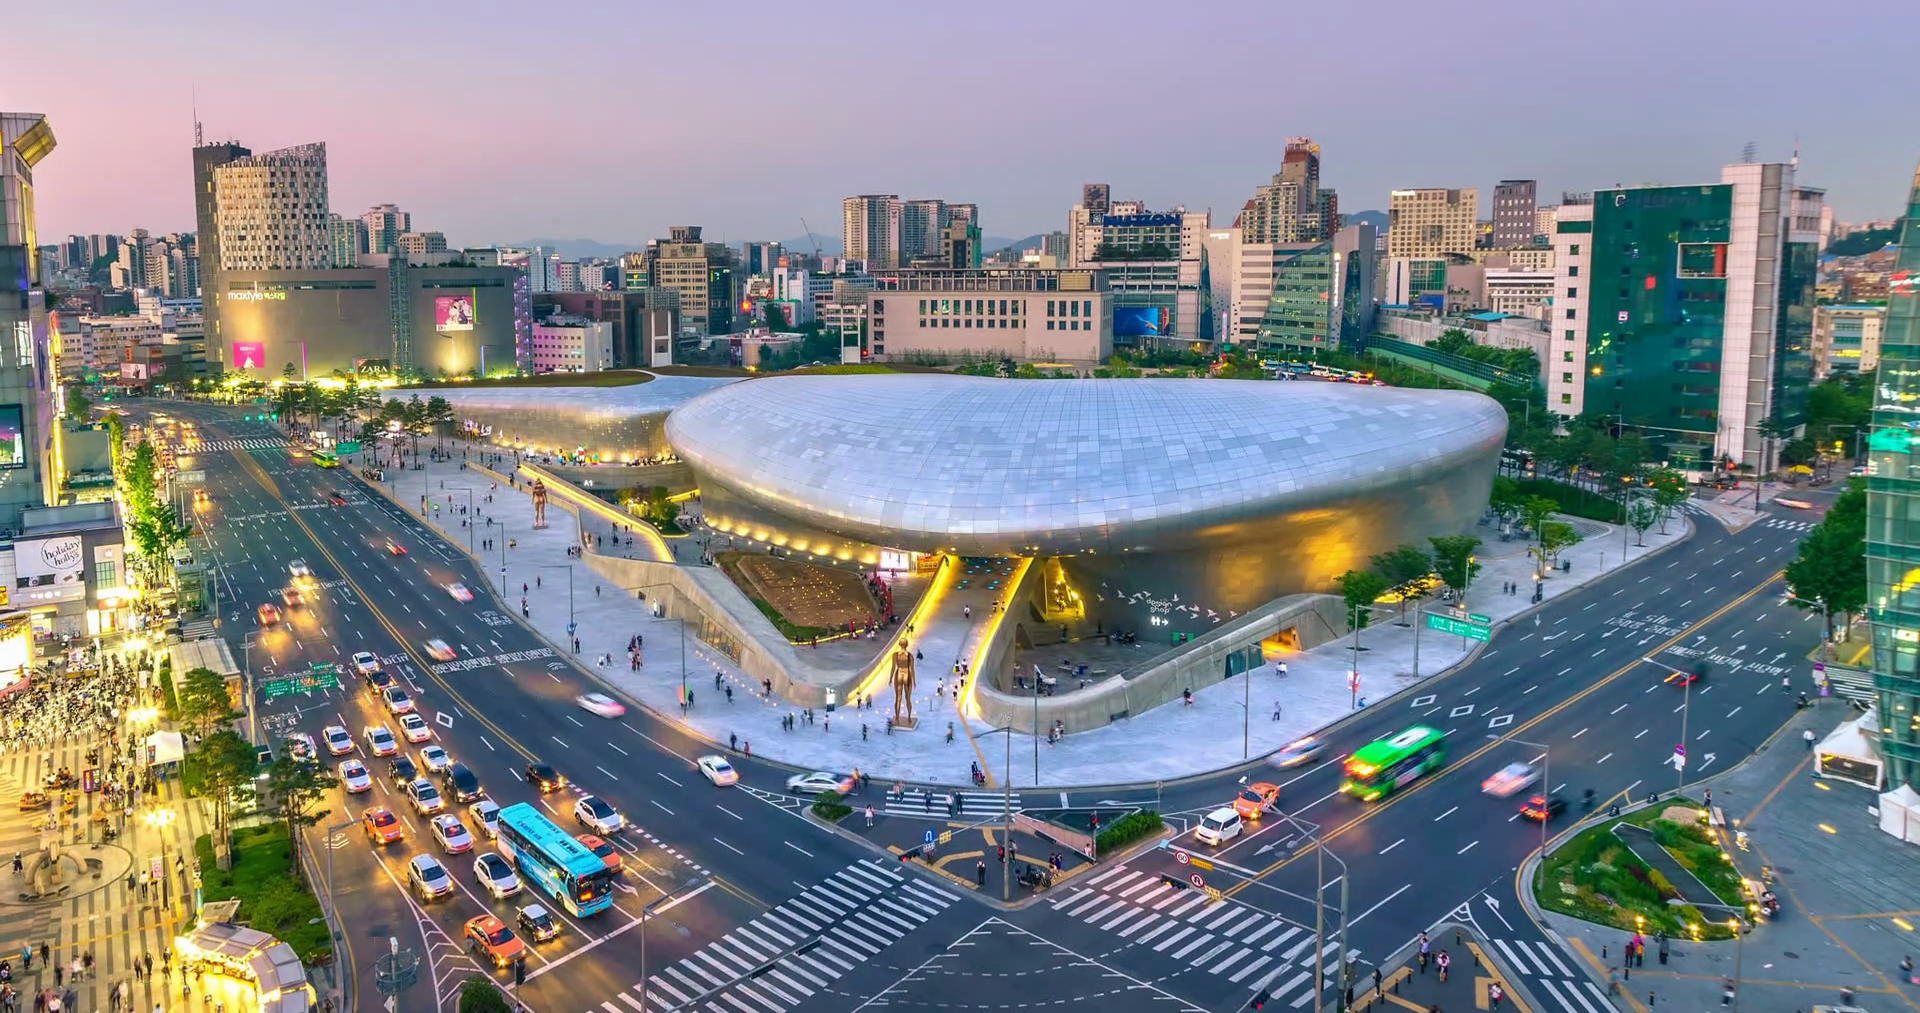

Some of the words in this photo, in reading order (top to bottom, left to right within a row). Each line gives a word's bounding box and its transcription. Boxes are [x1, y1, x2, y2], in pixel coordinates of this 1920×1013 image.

[361, 365, 388, 373] ZARA
[584, 479, 593, 487] A1
[44, 542, 80, 560] holiday
[1146, 598, 1172, 608] design
[1150, 604, 1170, 614] shop
[1177, 852, 1188, 862] 60
